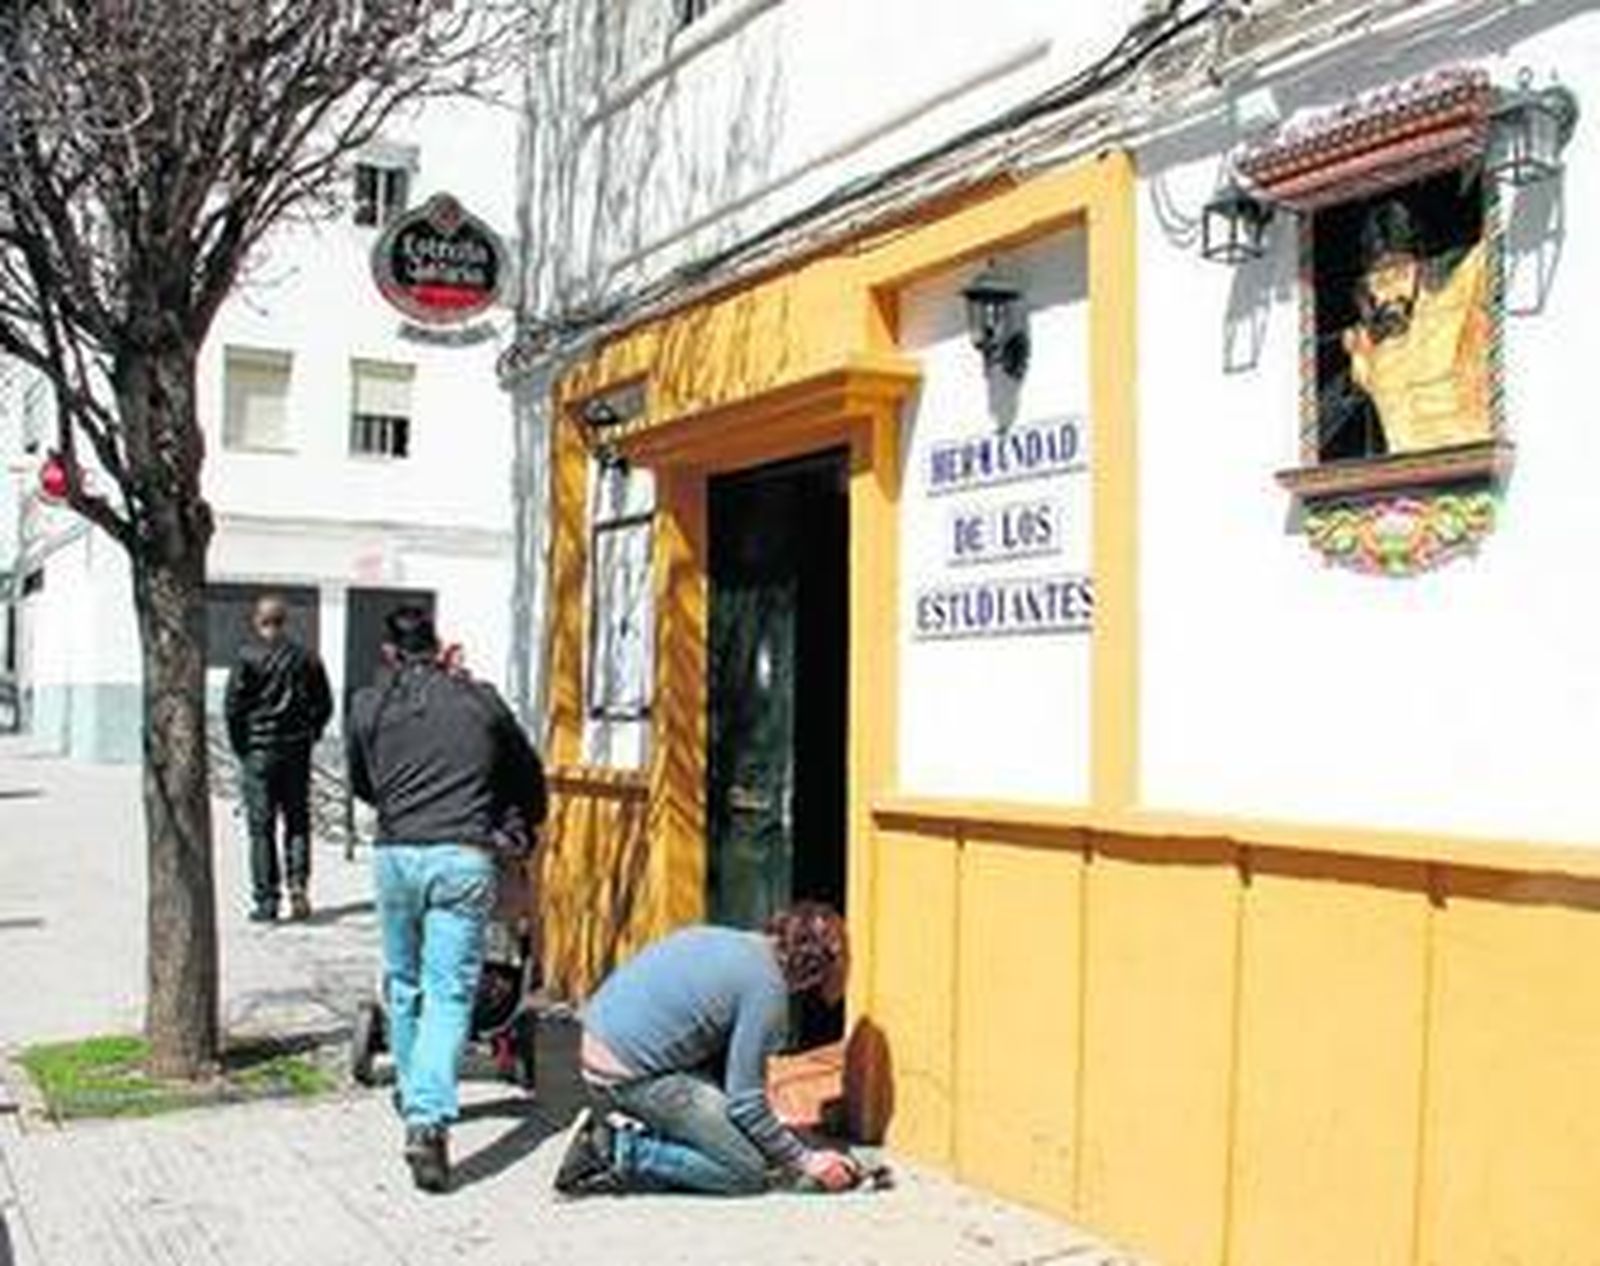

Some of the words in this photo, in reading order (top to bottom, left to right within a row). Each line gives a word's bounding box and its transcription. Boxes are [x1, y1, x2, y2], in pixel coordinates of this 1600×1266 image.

[953, 517, 986, 555] DE
[1002, 504, 1052, 549] LOS
[916, 577, 1094, 631] ESTUDIANTES
